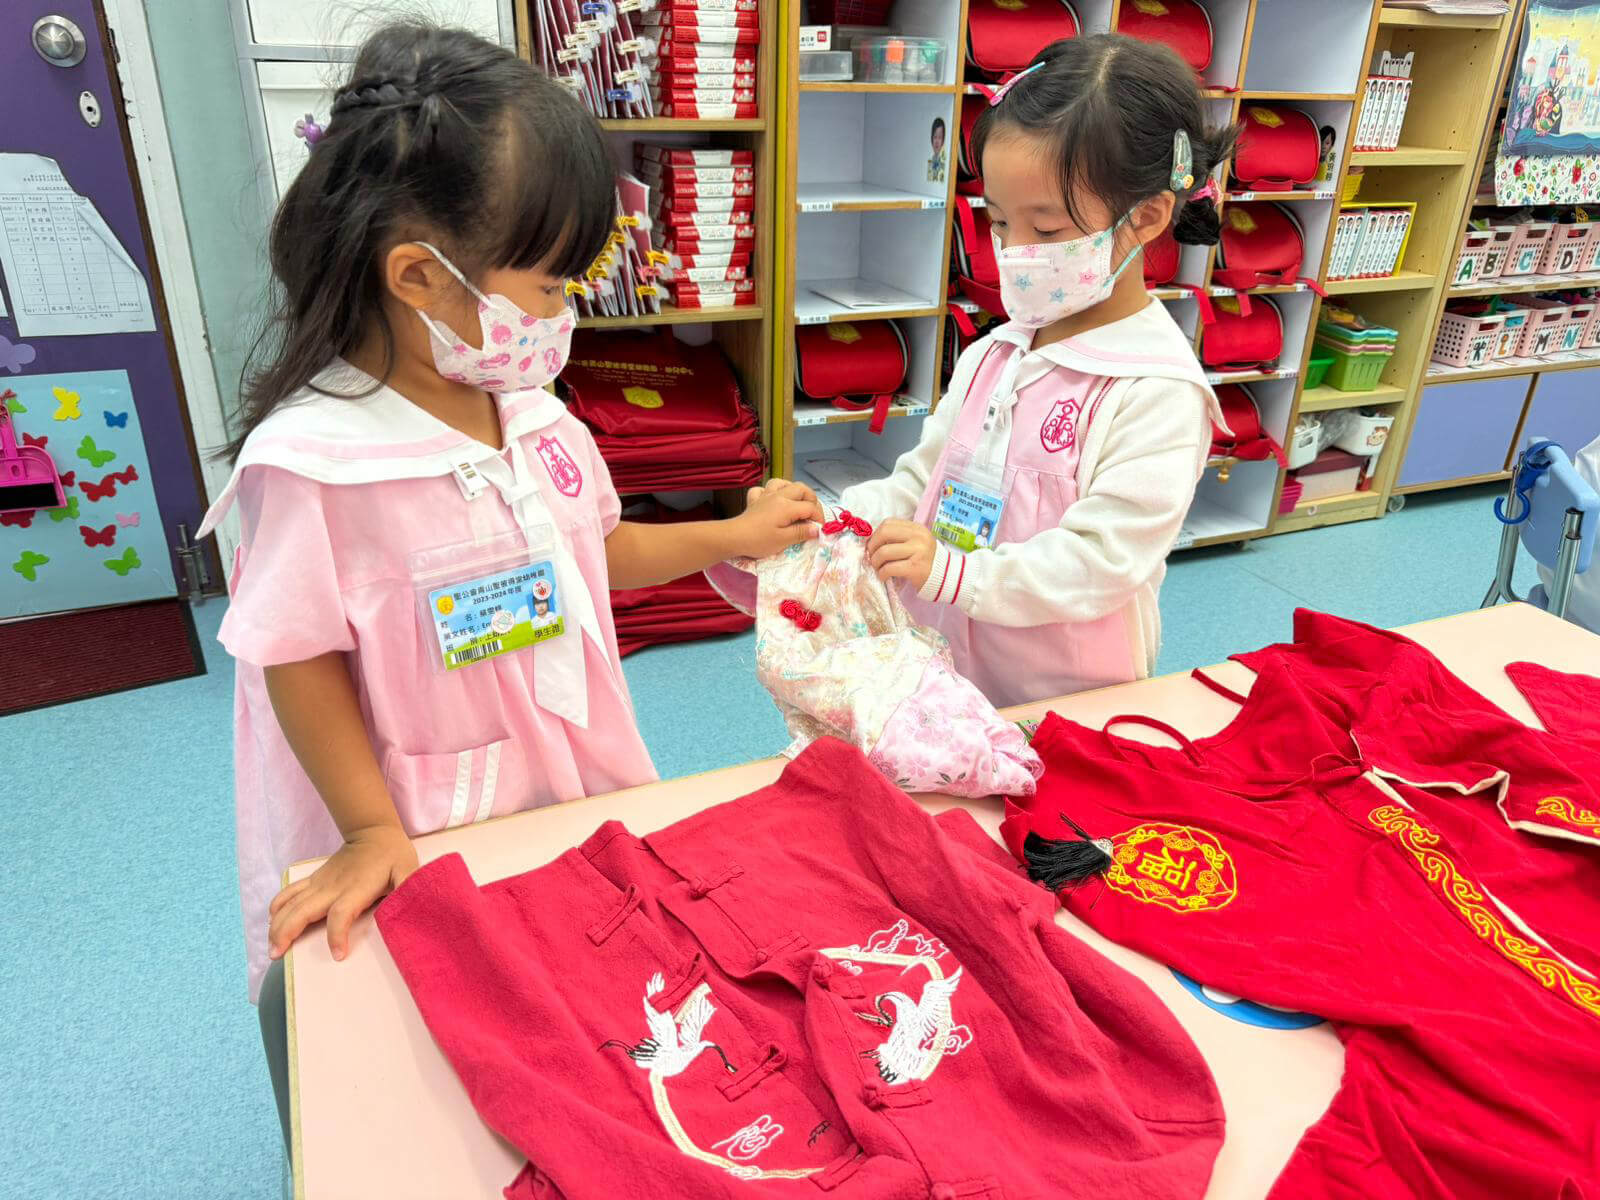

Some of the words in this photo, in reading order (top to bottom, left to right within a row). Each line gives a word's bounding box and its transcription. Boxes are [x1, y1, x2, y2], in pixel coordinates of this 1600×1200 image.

[1458, 259, 1473, 281] A
[1482, 253, 1498, 274] B
[1519, 250, 1533, 270] C
[1560, 251, 1574, 269] D
[1535, 333, 1549, 353] M
[1562, 327, 1579, 348] N
[472, 591, 507, 605] 2023-2024
[508, 586, 522, 596] 年度
[534, 624, 560, 637] 學生證
[1136, 847, 1197, 890] 福
